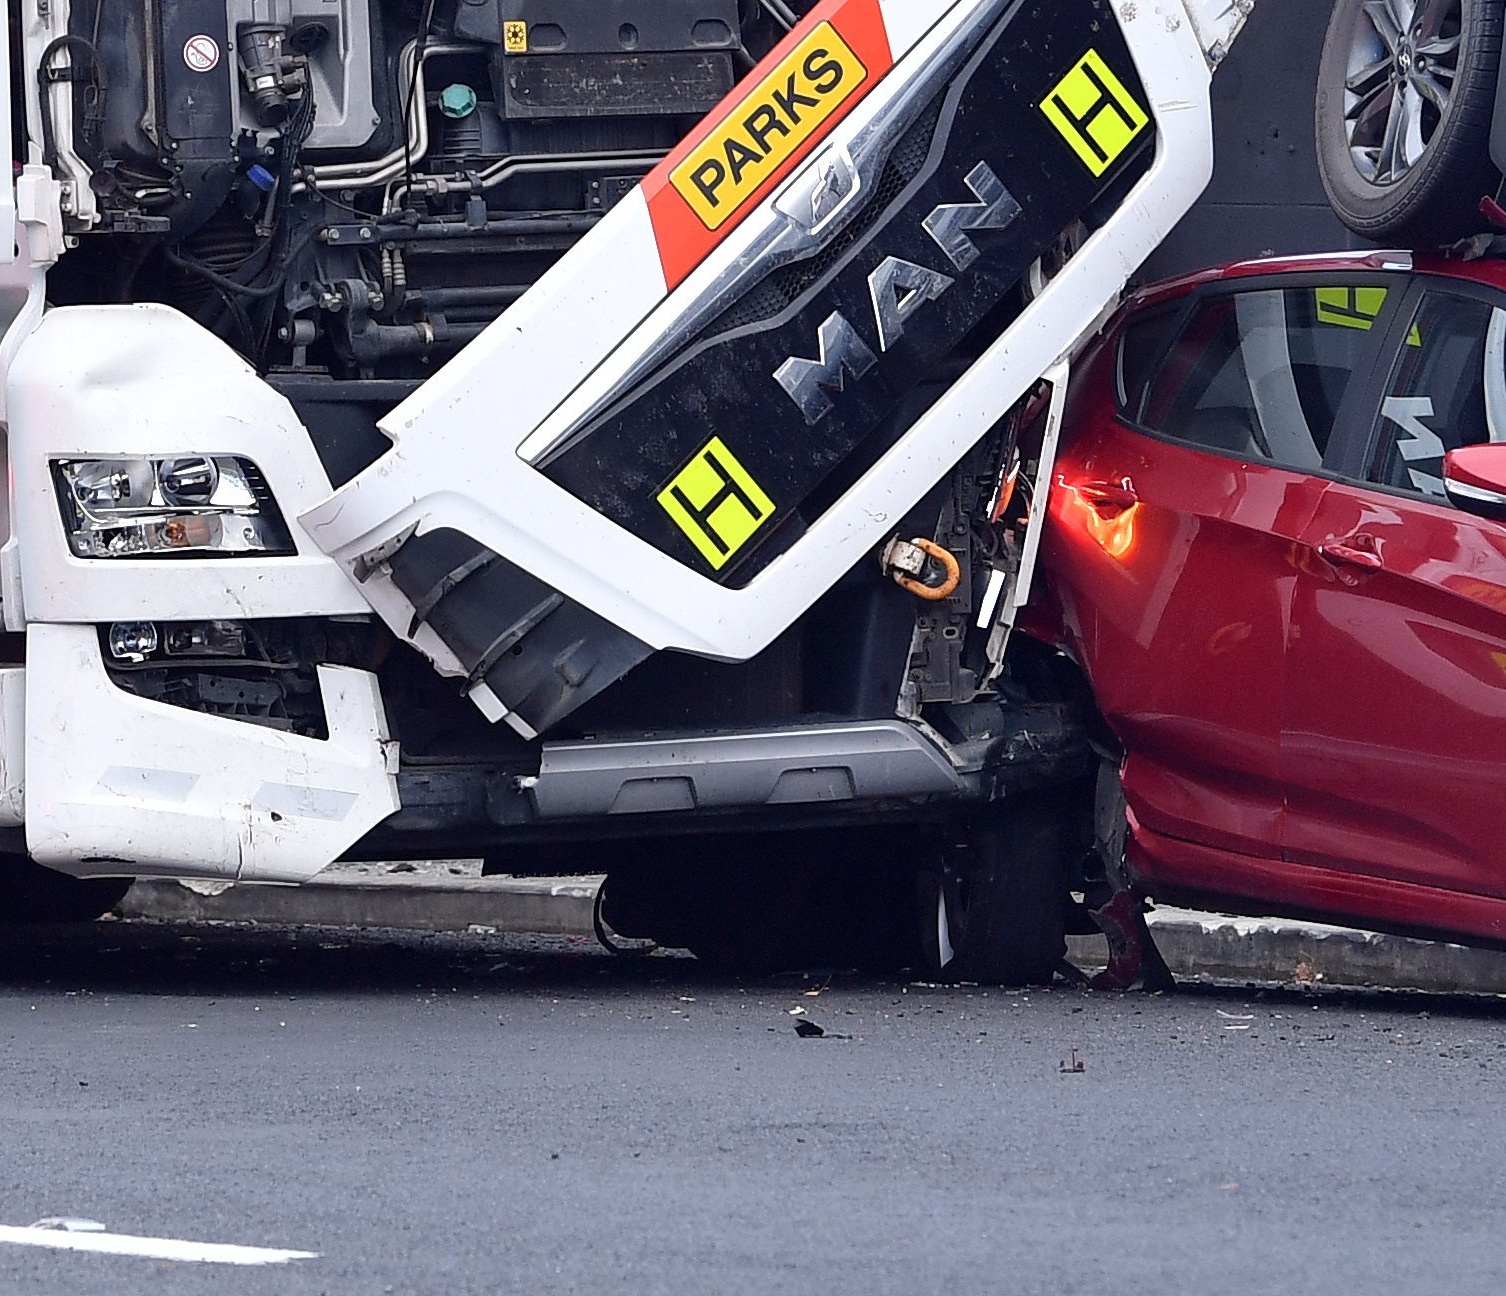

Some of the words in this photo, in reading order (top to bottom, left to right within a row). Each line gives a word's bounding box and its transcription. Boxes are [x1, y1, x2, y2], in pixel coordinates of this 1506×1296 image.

[689, 48, 843, 208] PARKS
[1051, 61, 1138, 164] H
[772, 160, 1023, 426] MAN
[670, 450, 763, 556] H
